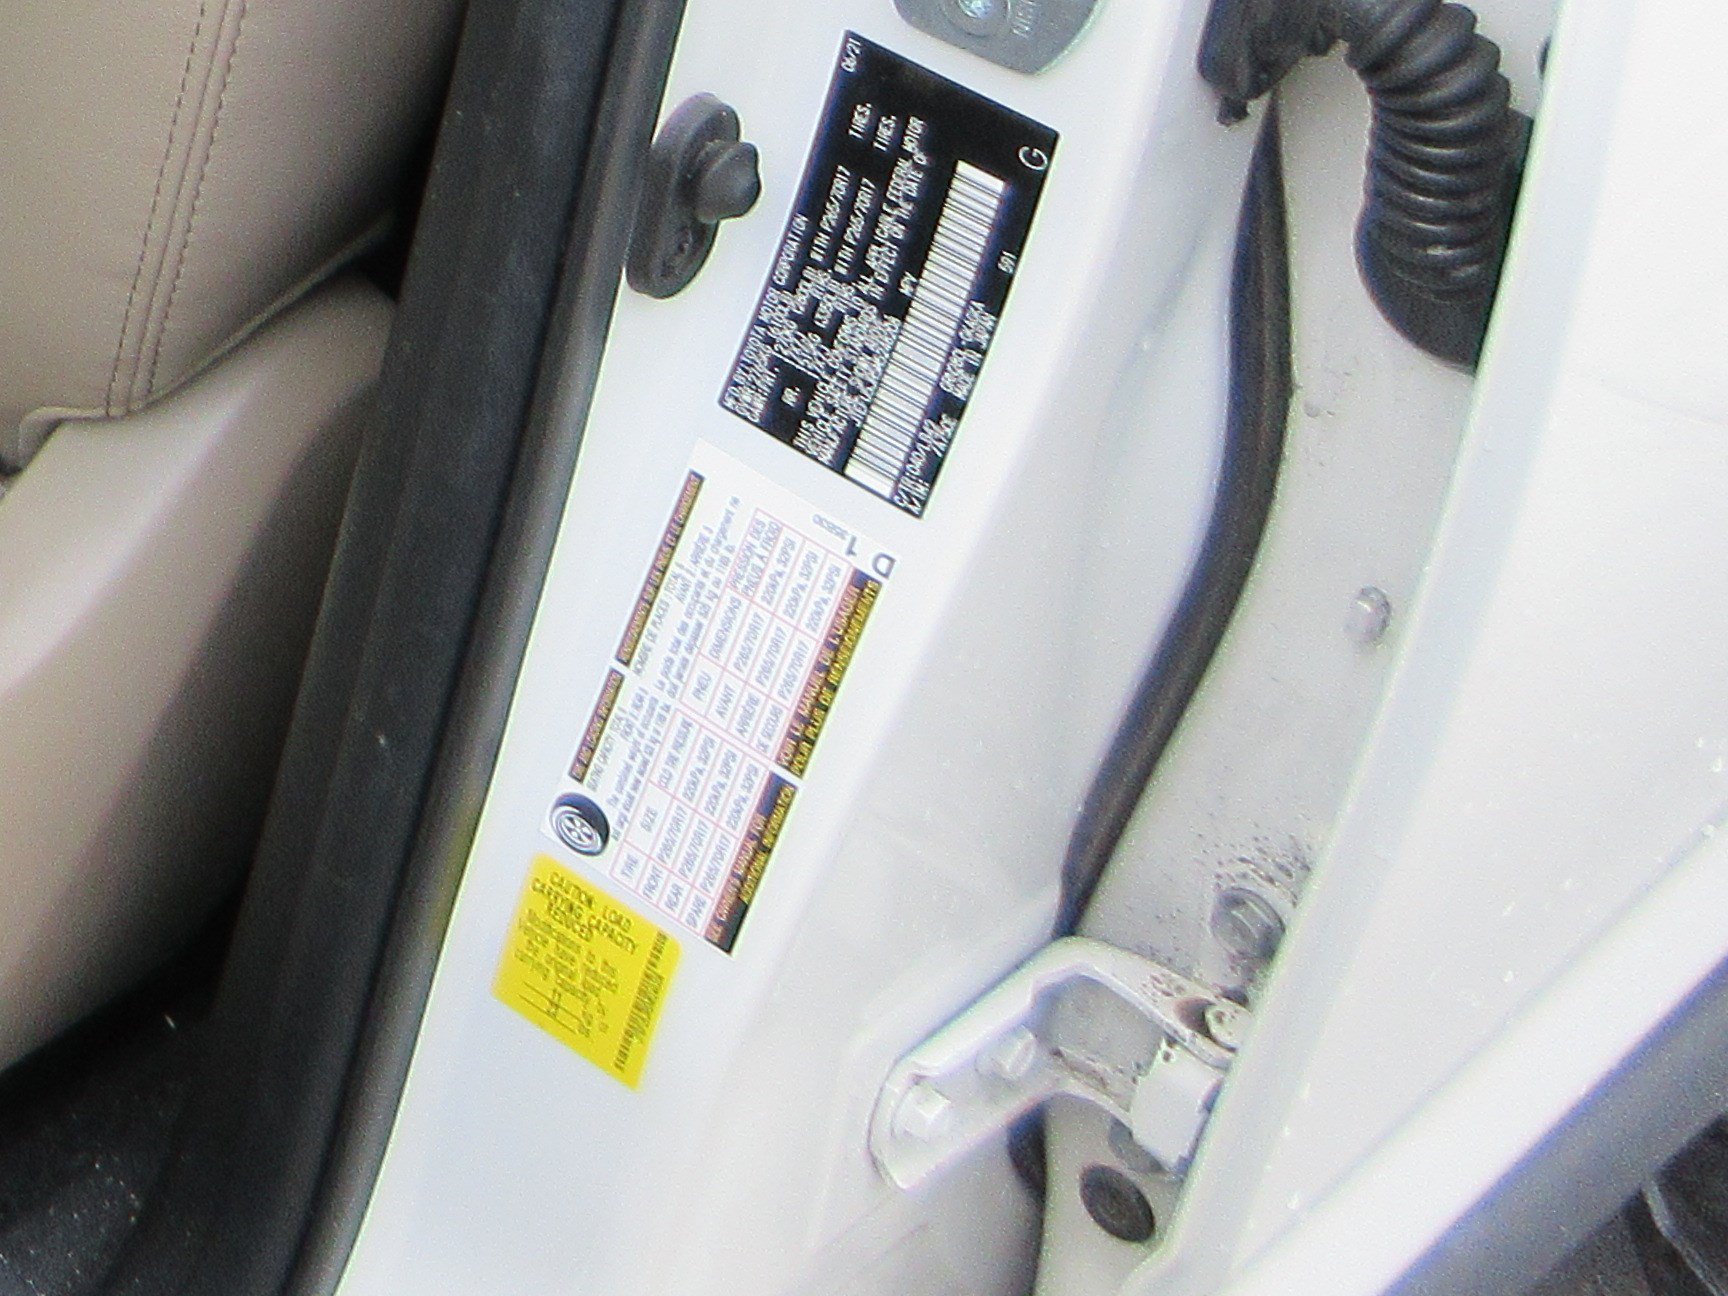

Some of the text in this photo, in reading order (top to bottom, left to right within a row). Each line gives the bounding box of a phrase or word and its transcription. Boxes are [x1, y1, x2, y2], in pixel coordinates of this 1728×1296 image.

[839, 37, 864, 73] 06/21
[899, 114, 926, 154] MOTOR
[910, 147, 929, 166] OF
[1015, 141, 1050, 174] G
[884, 154, 913, 204] FEDERAL
[901, 165, 924, 197] DATE
[817, 164, 853, 233] P265/70R17
[841, 176, 877, 245] P265/70R17
[893, 195, 914, 221] THE
[808, 230, 830, 263] WITH
[863, 201, 899, 270] APPLICABLE
[887, 219, 907, 240] ON
[756, 284, 781, 325] MOTOR
[771, 211, 808, 287] CORPORATION
[832, 242, 855, 276] WITH
[872, 240, 900, 284] EFFECT
[853, 271, 873, 295] ALL
[866, 281, 885, 301] IN
[897, 270, 918, 298] MPV
[846, 292, 864, 312] TO
[825, 311, 857, 370] CONFORMS
[805, 368, 834, 421] VEHICLE
[792, 417, 814, 451] THIS
[804, 405, 835, 459] VEHICLE
